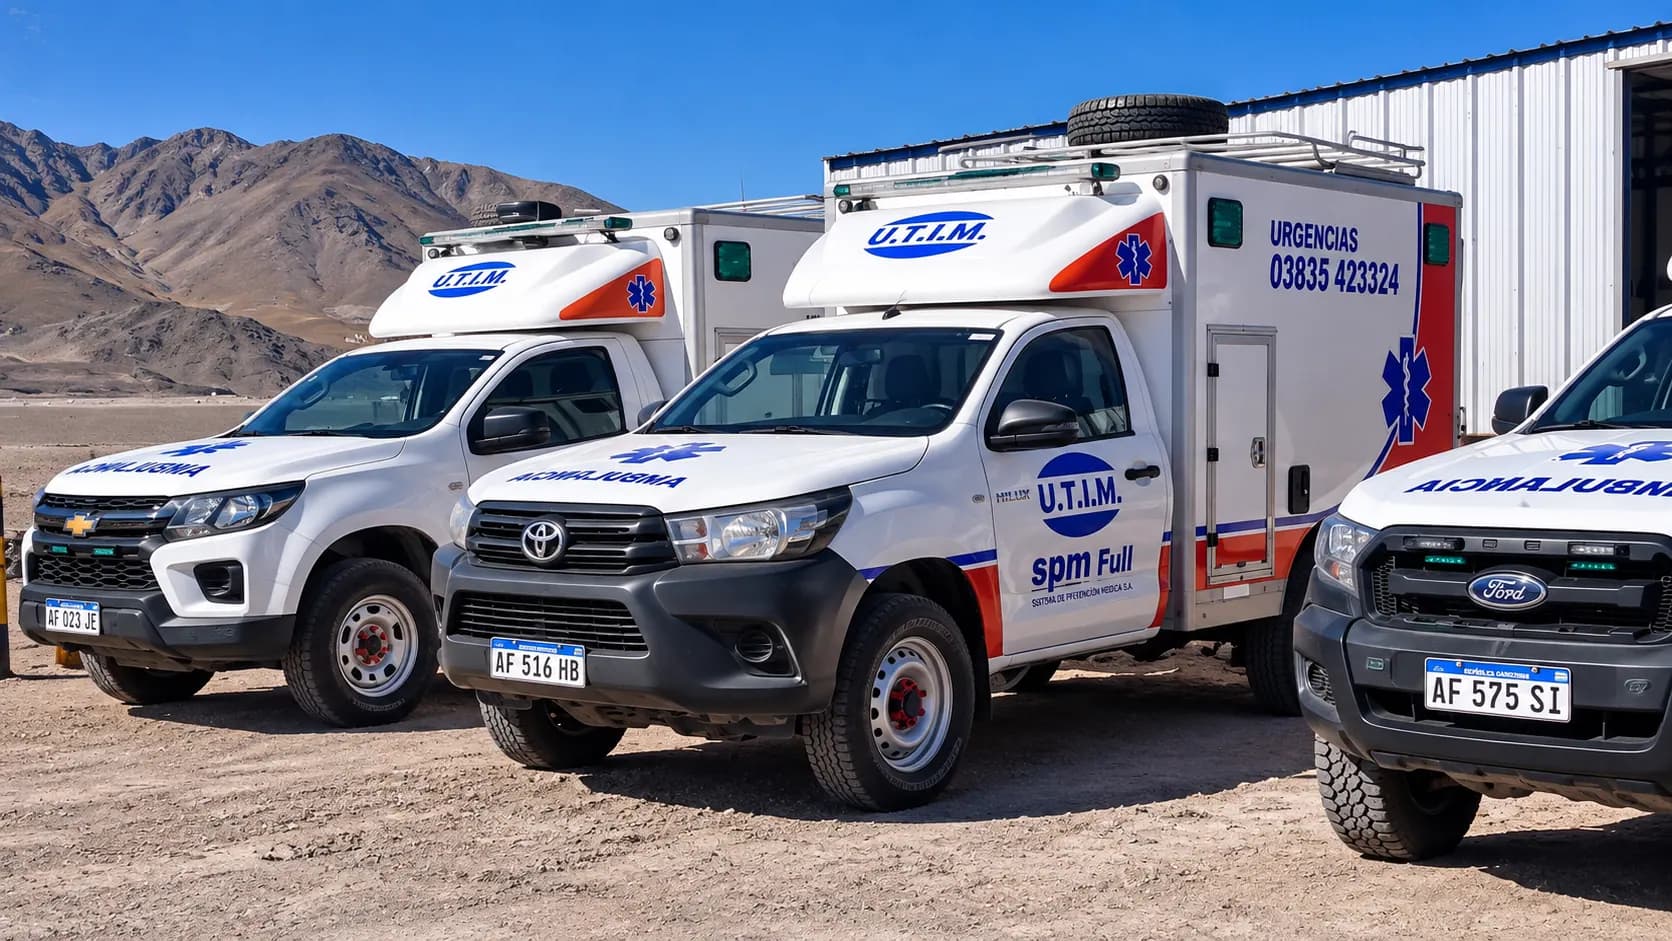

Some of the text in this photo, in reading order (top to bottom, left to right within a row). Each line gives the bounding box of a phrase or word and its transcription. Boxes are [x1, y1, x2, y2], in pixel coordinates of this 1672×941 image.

[868, 222, 987, 246] U.T.I.M.
[1270, 220, 1358, 253] URGENCIAS
[432, 269, 509, 288] U.T.I.M.
[1270, 253, 1400, 296] 03835 423324
[995, 488, 1031, 504] HILUX
[1037, 476, 1122, 514] U.T.I.M.
[1031, 544, 1134, 593] spm Full
[1483, 578, 1527, 601] Ford
[48, 609, 97, 631] AF 023 JE
[495, 651, 579, 681] AF 516 HB
[1432, 676, 1562, 715] AF 575 SI
